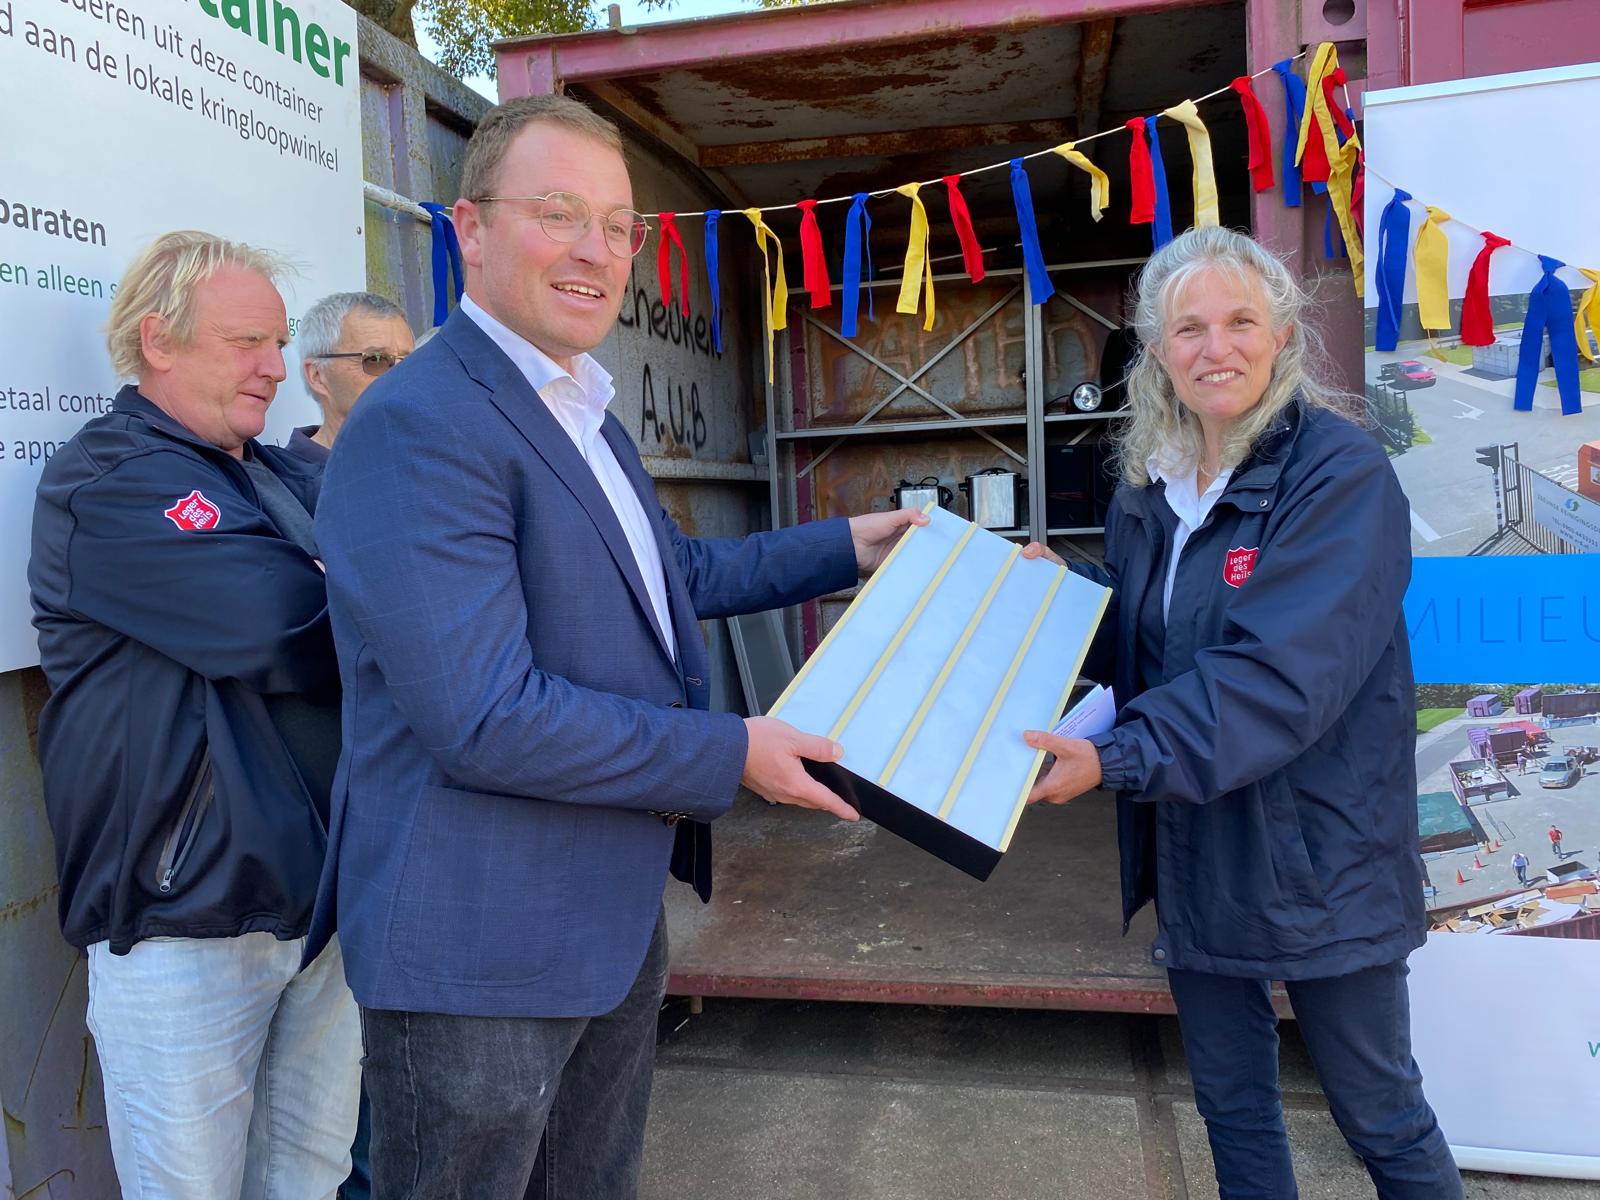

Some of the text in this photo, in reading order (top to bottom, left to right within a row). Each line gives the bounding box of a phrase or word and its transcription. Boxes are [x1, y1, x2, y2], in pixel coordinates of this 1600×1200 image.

[154, 25, 183, 58] uit
[191, 39, 236, 82] deze
[243, 70, 323, 123] container
[25, 20, 76, 62] aan
[86, 41, 117, 79] de
[126, 54, 194, 111] lokale
[200, 87, 339, 172] kringloopwinkel
[37, 264, 103, 298] alleen
[178, 498, 199, 520] Leger
[189, 507, 204, 522] des
[193, 511, 214, 530] Heils
[1230, 553, 1253, 565] Leger
[1233, 563, 1248, 572] des
[1230, 570, 1253, 582] Heils
